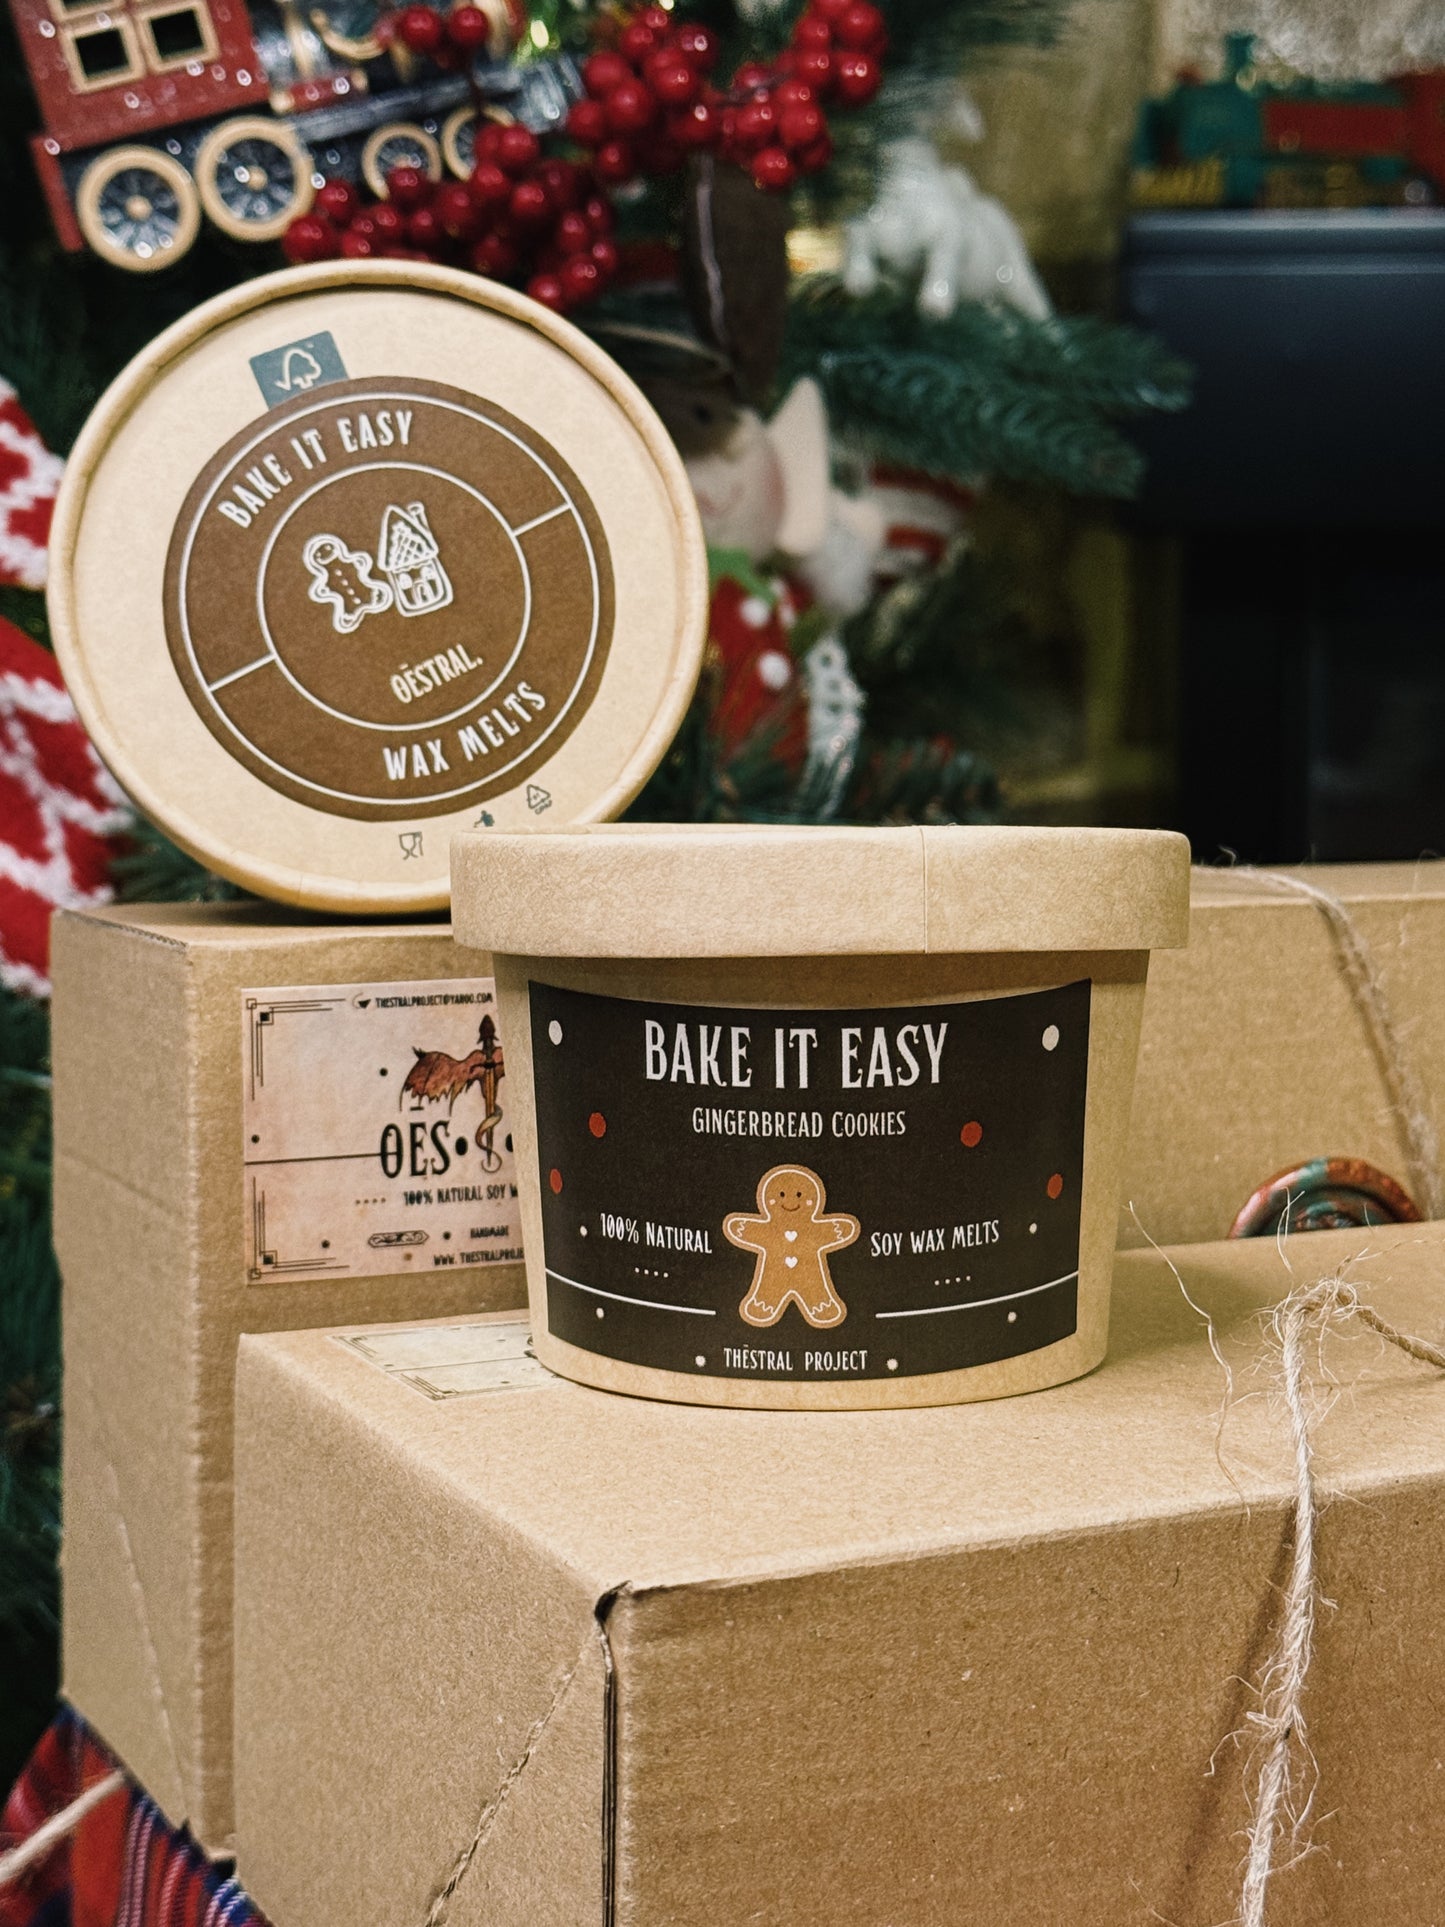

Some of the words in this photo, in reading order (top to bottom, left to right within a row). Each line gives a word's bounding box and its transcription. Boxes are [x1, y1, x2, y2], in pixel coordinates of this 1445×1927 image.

[217, 453, 293, 529] BAKE
[290, 428, 327, 470] IT
[337, 410, 413, 453] EASY
[383, 738, 450, 781] WAX
[457, 681, 546, 762] MELTS
[645, 1019, 752, 1088] BAKE
[775, 1028, 818, 1089] IT
[841, 1022, 948, 1089] EASY
[692, 1107, 823, 1138] GINGERBREAD
[832, 1110, 906, 1138] COOKIES
[403, 1189, 433, 1206] 100%
[437, 1185, 483, 1203] NATURAL
[486, 1184, 506, 1199] SOY
[600, 1212, 640, 1244] 100%
[645, 1221, 713, 1254] NATURAL
[870, 1231, 903, 1257] SOY
[910, 1228, 945, 1254] WAX
[951, 1219, 999, 1249] MELTS
[804, 1350, 868, 1371] PROJECT
